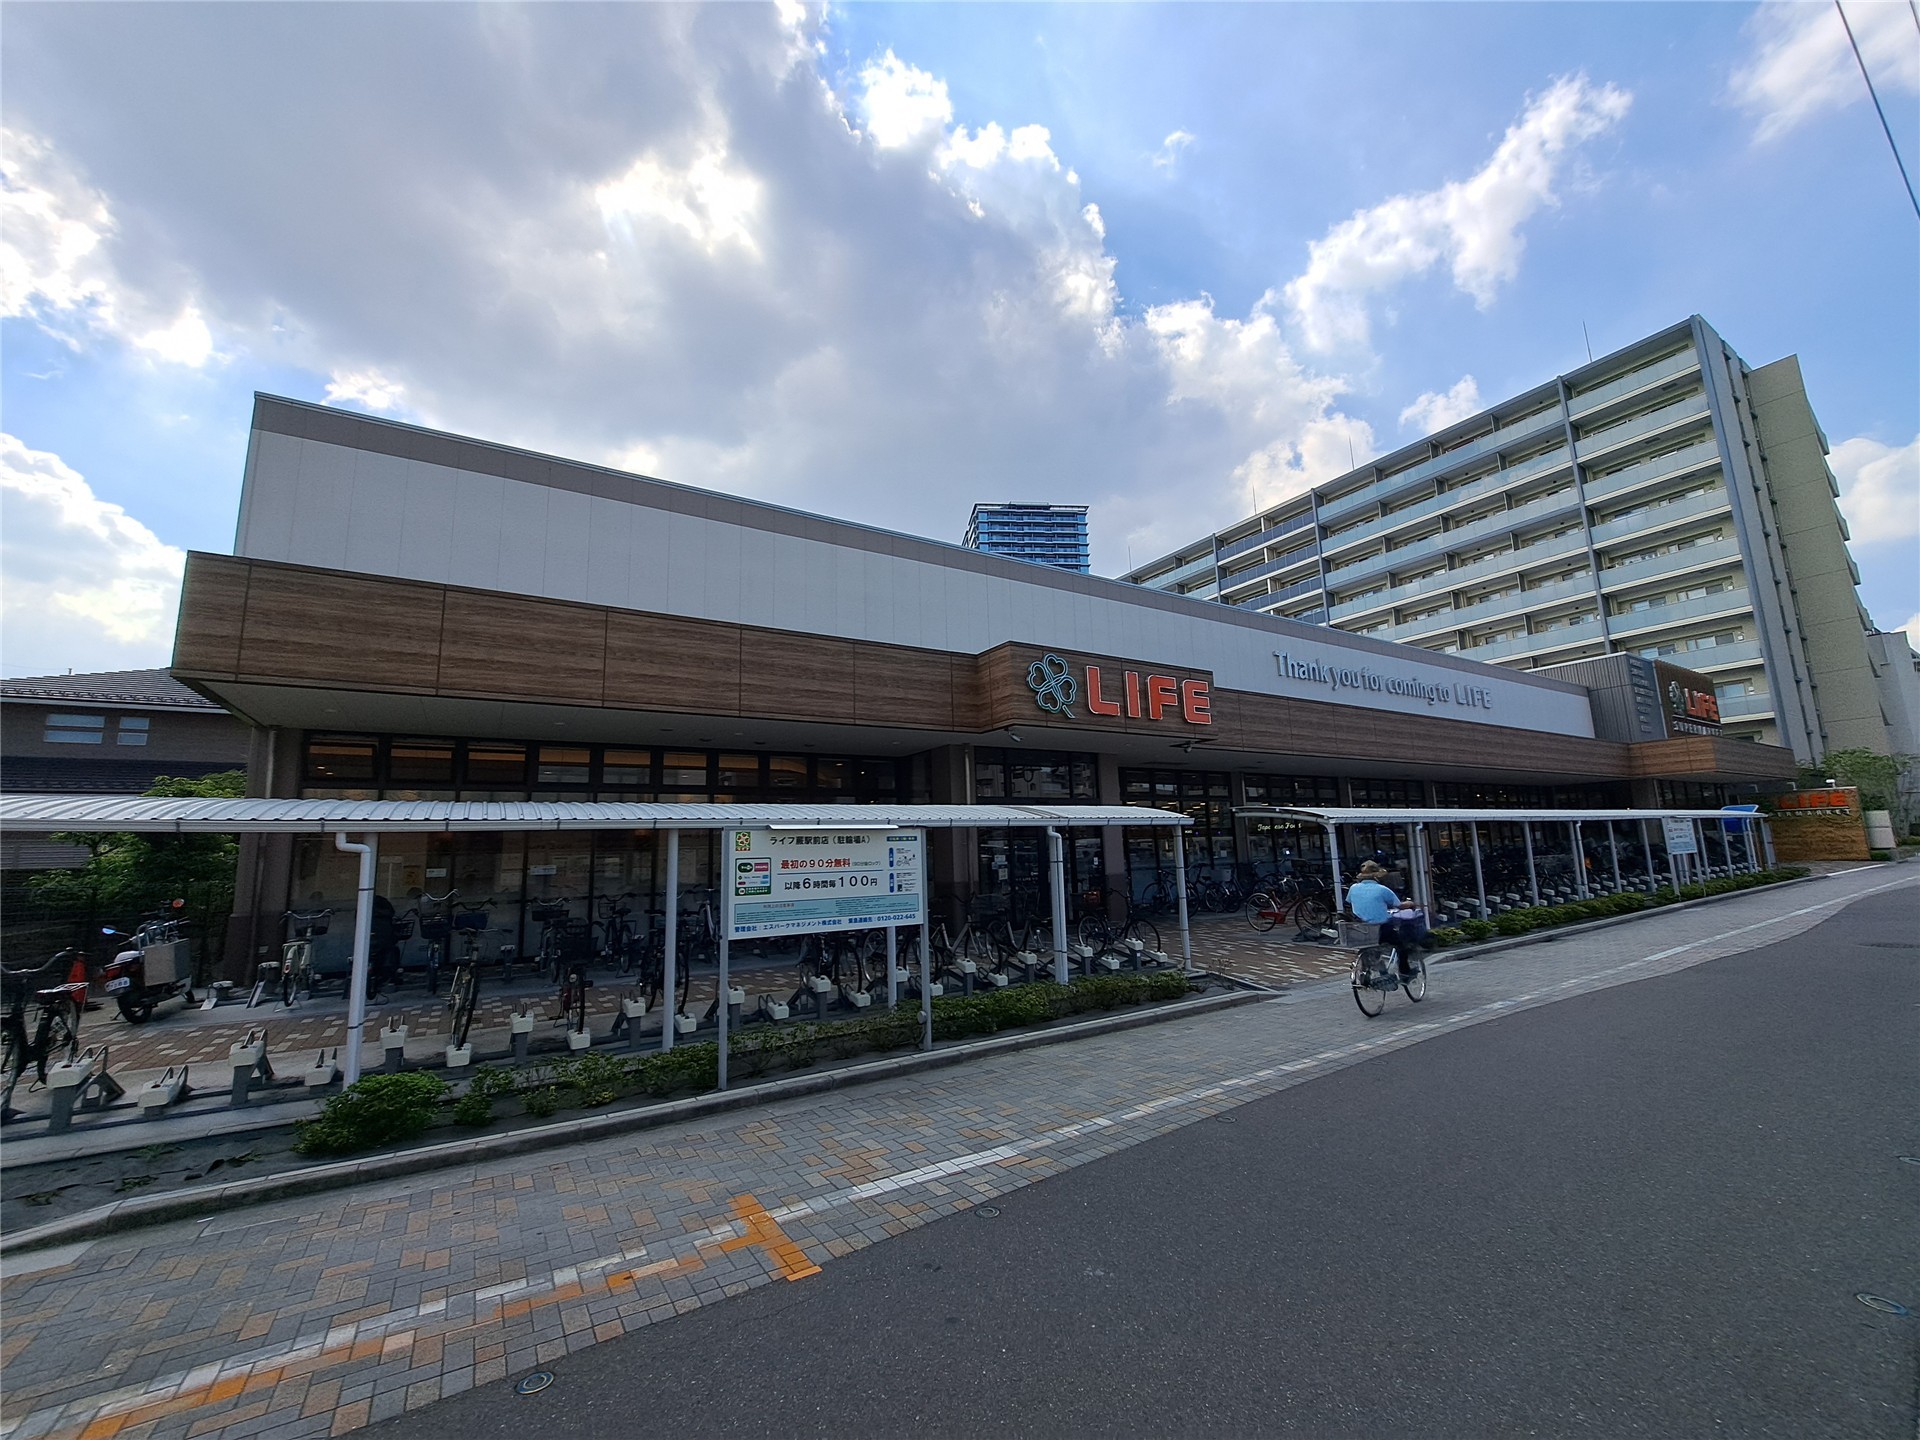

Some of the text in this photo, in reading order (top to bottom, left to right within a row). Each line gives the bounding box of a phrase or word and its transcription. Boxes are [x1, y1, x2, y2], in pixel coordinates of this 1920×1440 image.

[1085, 664, 1213, 725] LIFE
[1272, 649, 1493, 710] Thank you for coming to LIFE
[1683, 688, 1719, 720] LIFE
[1673, 720, 1723, 736] SUPERMARKET
[1779, 791, 1846, 809] LIFE
